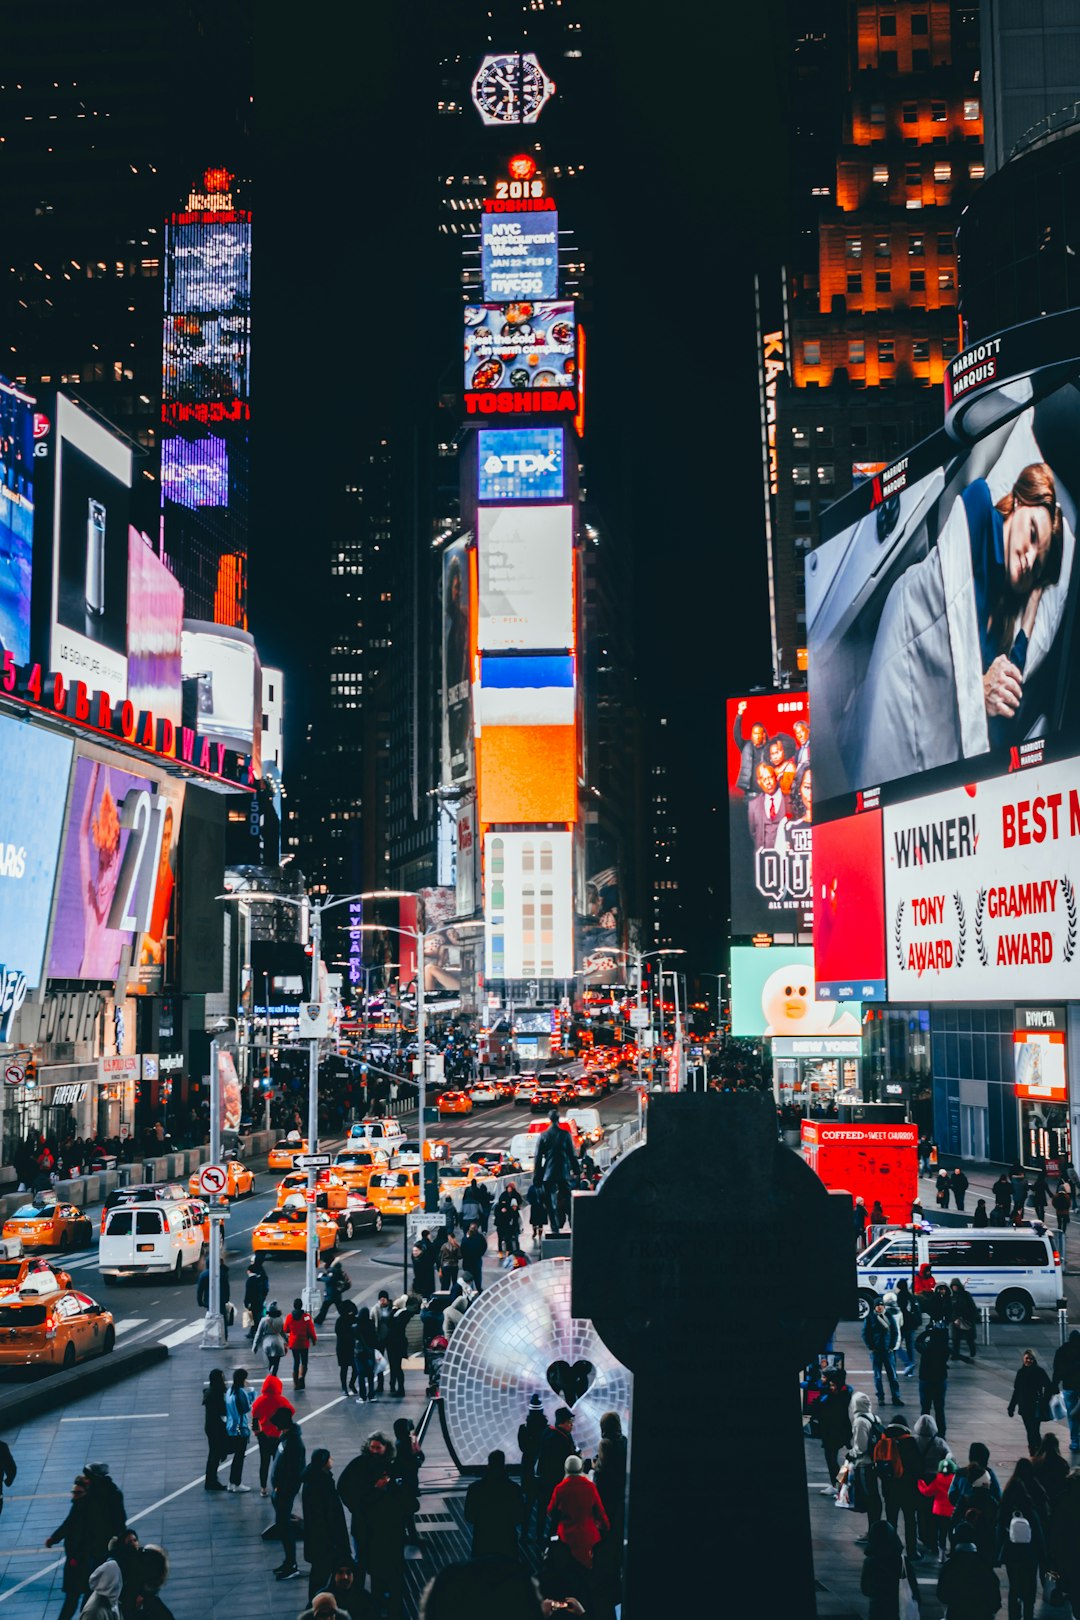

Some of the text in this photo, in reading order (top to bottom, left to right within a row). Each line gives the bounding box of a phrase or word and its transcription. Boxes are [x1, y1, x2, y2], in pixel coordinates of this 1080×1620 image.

[496, 181, 543, 199] 2018
[484, 197, 556, 213] TOSHIBA
[484, 232, 556, 246] Restaurant
[492, 223, 522, 236] NYC
[491, 245, 529, 256] Week
[490, 259, 509, 268] JAN
[953, 338, 1001, 377] MARRIOTT
[953, 361, 995, 397] MARQUIS
[464, 391, 576, 414] TOSHIBA
[501, 453, 557, 472] TDK
[883, 457, 909, 482] MARRIOTT
[883, 473, 907, 497] MARQUIS
[76, 680, 227, 777] BROADWAY
[1020, 740, 1046, 754] MARRIOTT
[1020, 752, 1043, 766] MARQUIS
[1002, 792, 1062, 849] BEST
[894, 814, 979, 869] WINNER!
[118, 789, 168, 933] 21
[911, 895, 945, 926] TONY
[988, 879, 1059, 919] GRAMMY
[907, 939, 954, 971] AWARD
[996, 931, 1053, 966] AWARD
[792, 1040, 859, 1052] NEW YORK
[52, 1084, 80, 1105] FOREVER
[821, 1131, 864, 1140] COFFEED
[868, 1131, 887, 1140] SWEET
